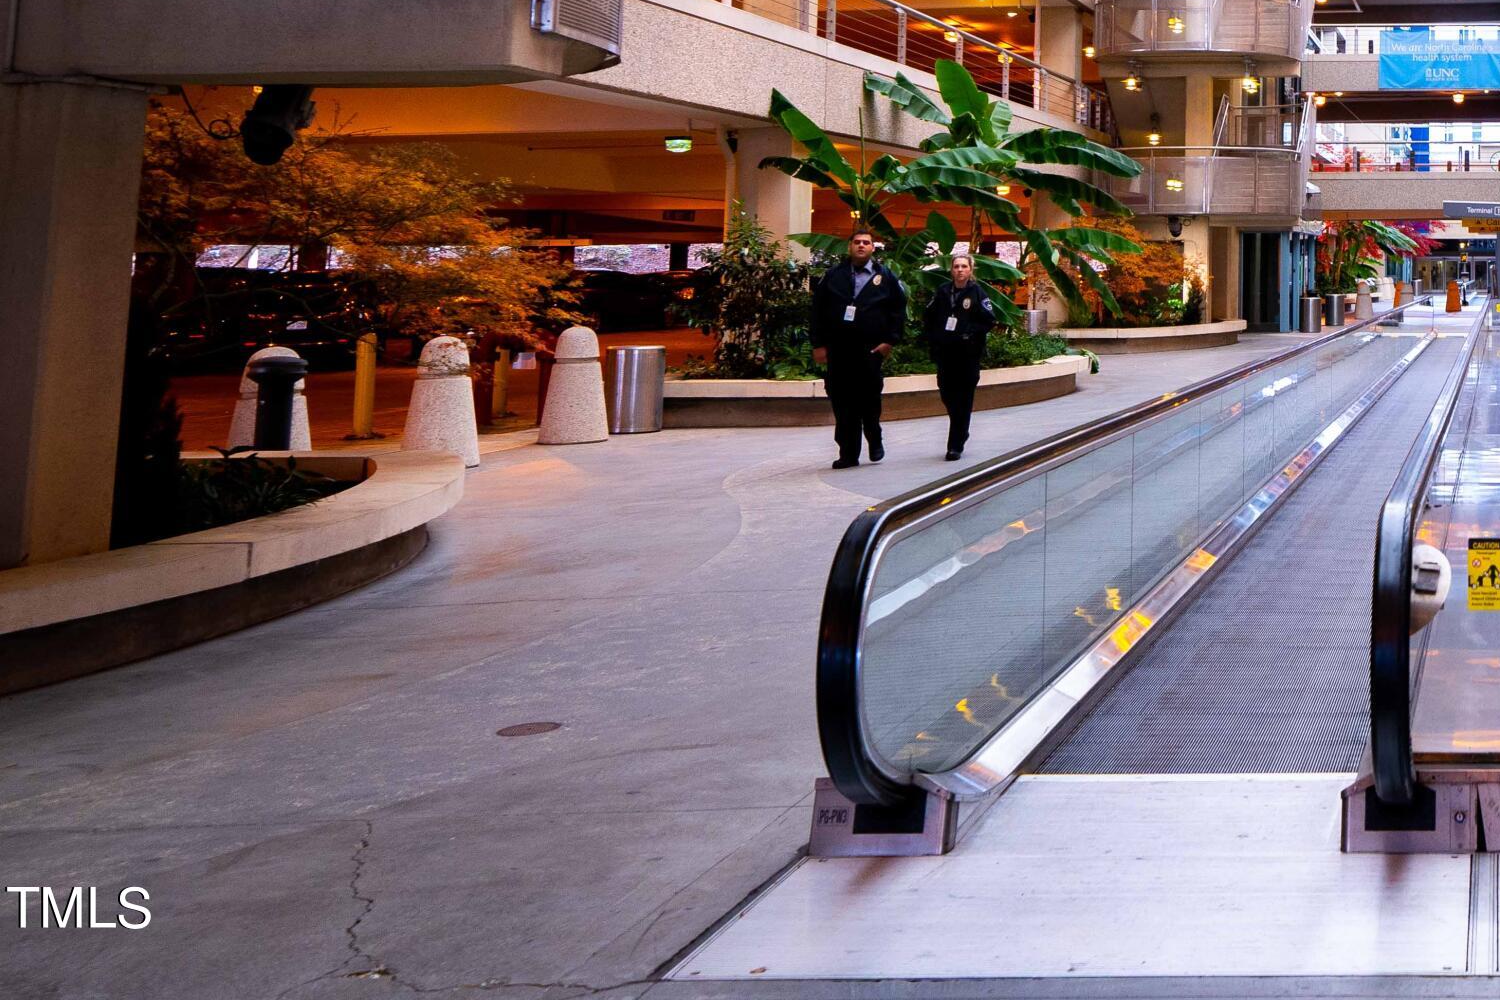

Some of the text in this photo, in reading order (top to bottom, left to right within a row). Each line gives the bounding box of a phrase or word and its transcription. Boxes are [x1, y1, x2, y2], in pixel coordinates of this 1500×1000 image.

[1391, 44, 1407, 52] We
[1425, 43, 1450, 52] North
[1412, 53, 1472, 63] health system
[1433, 68, 1459, 77] UNC
[1467, 206, 1493, 215] Terminal
[819, 809, 848, 824] PG-PW3
